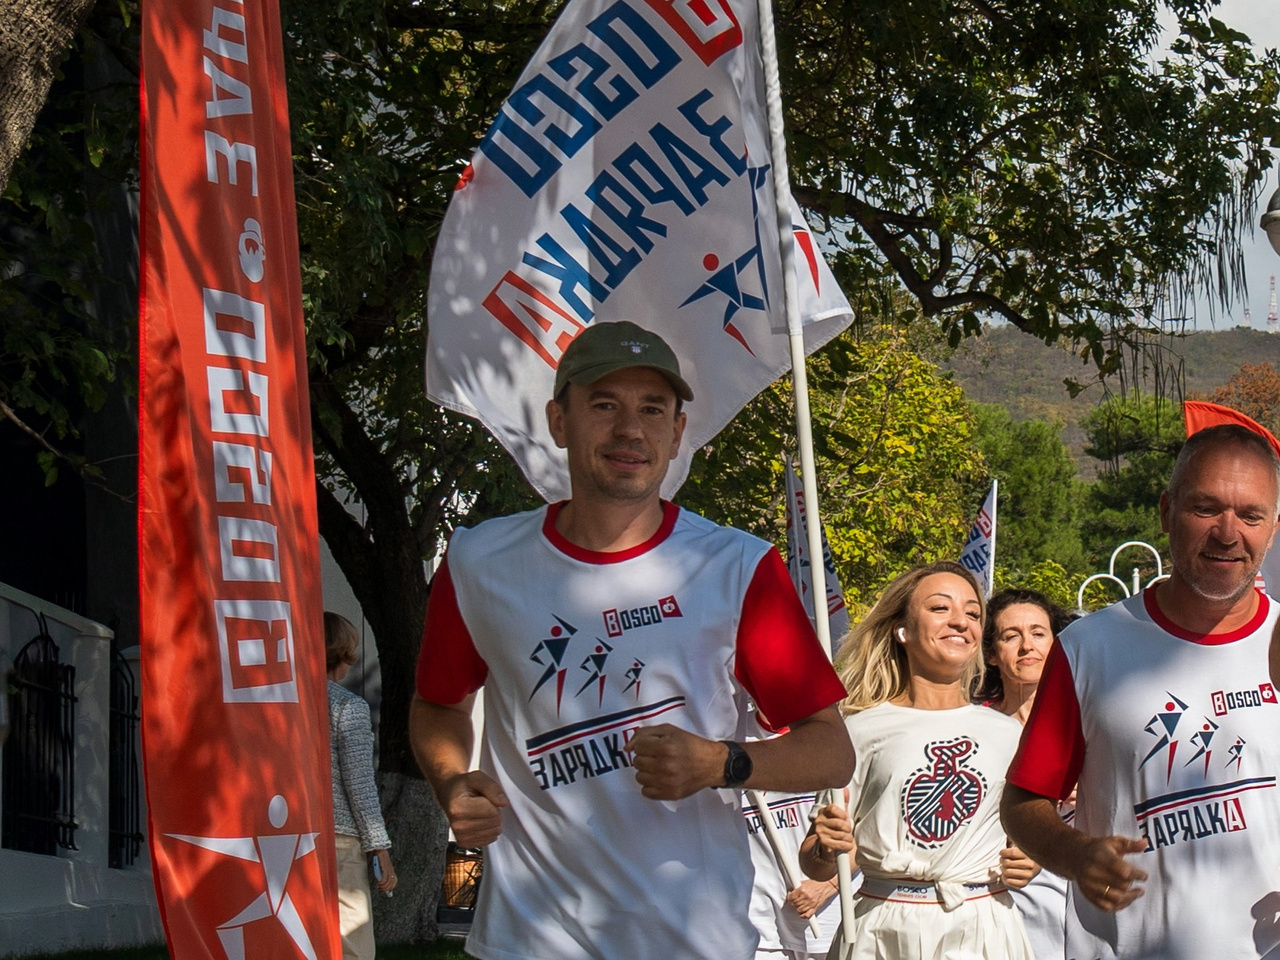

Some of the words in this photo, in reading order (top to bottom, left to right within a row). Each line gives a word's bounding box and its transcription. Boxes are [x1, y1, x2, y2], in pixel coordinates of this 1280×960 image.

[603, 603, 663, 638] BOSCO
[1211, 689, 1262, 717] BOSCO
[1138, 797, 1247, 853] ЗАРЯДКА
